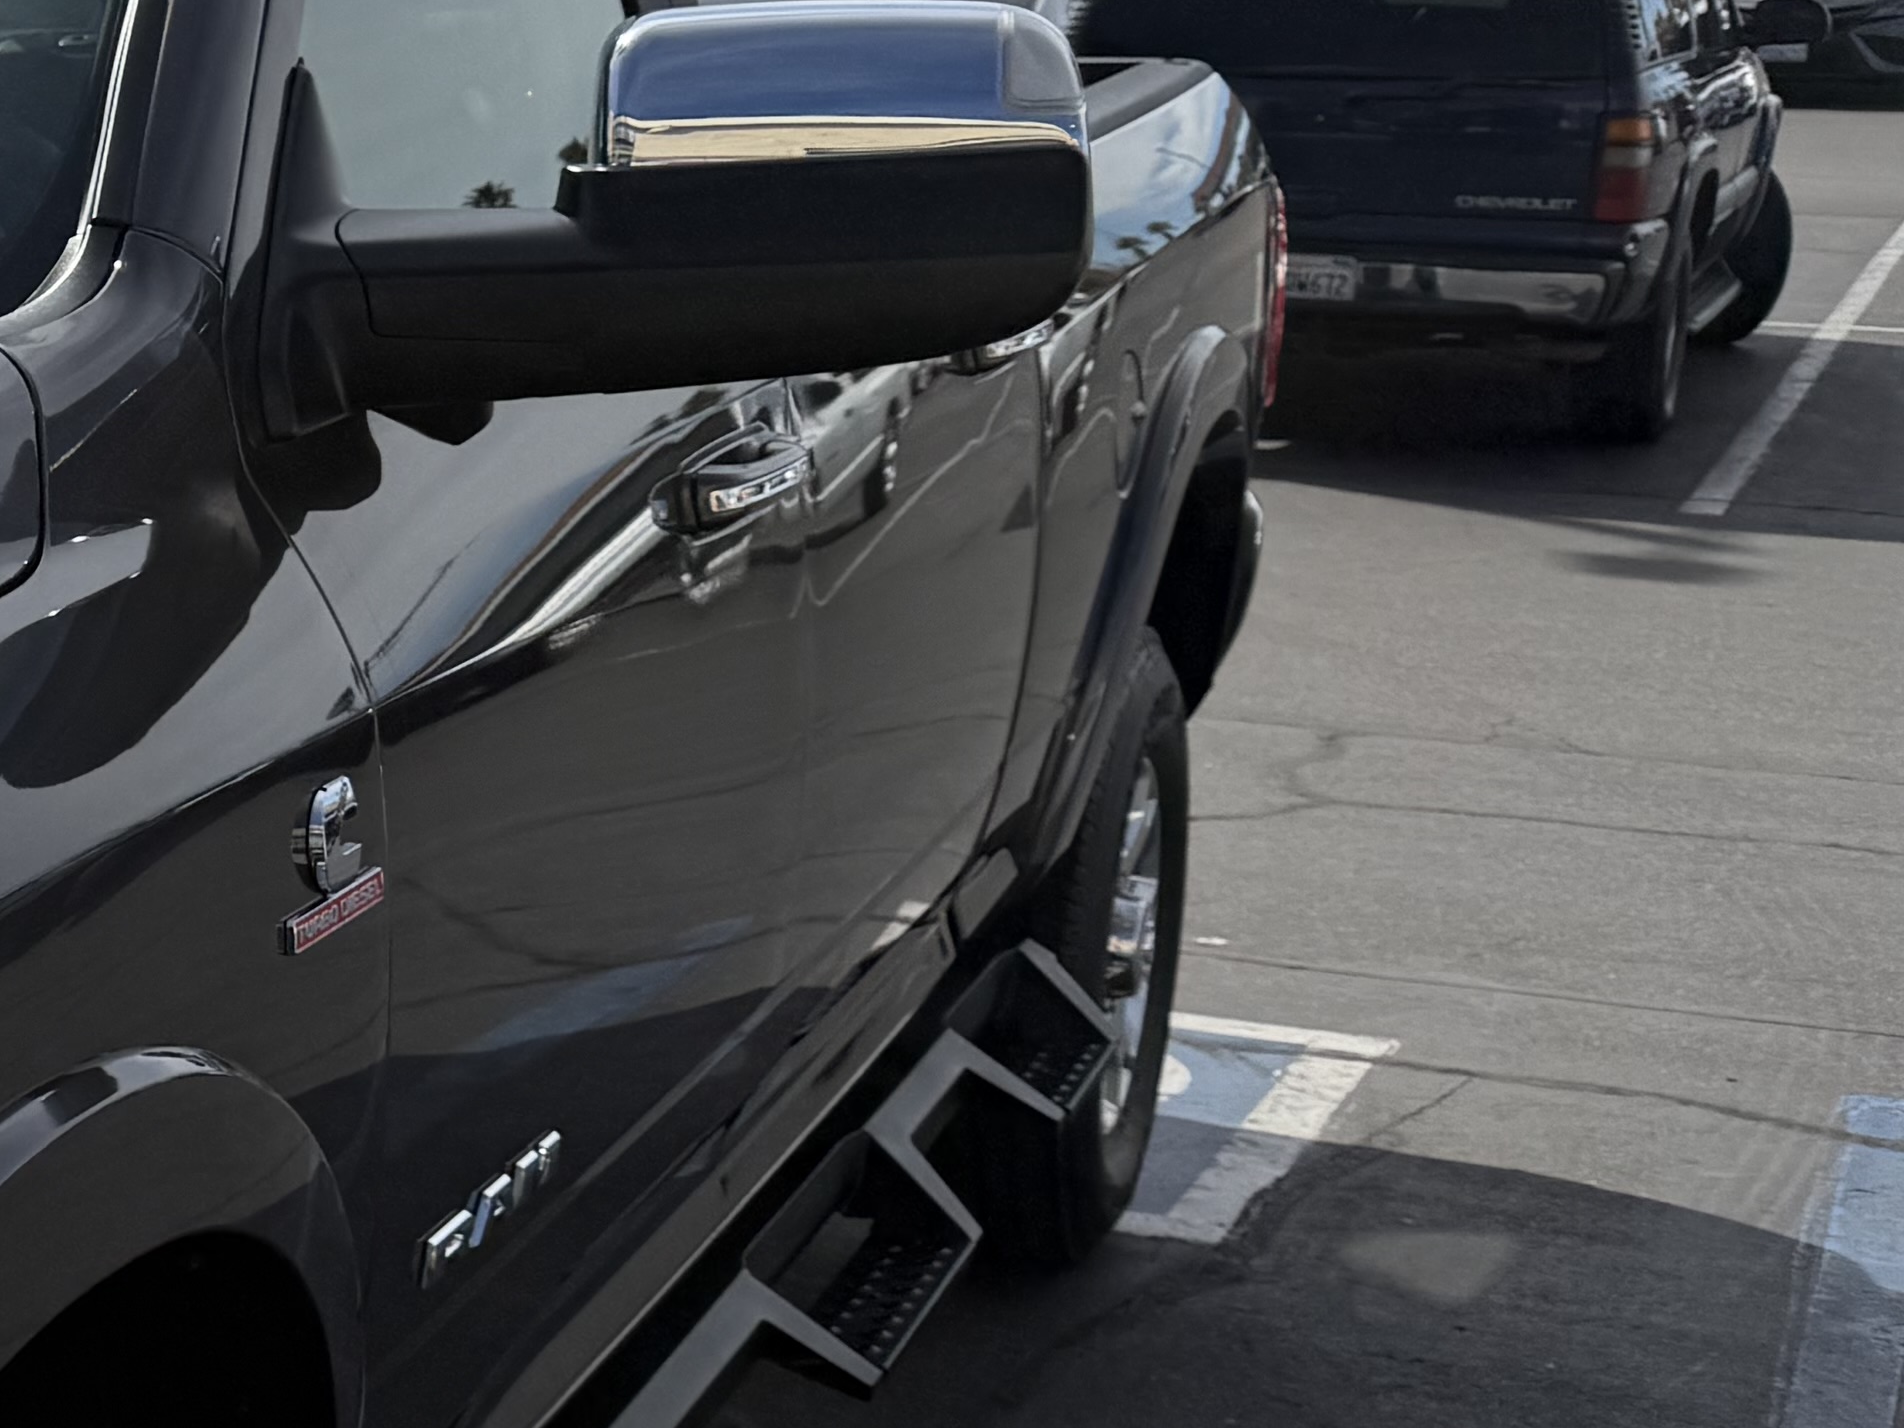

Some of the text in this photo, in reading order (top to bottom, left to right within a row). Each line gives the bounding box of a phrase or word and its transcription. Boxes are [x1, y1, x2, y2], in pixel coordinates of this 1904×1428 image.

[1455, 194, 1578, 211] CHEVROLET
[297, 877, 381, 943] TURBO DIESEL
